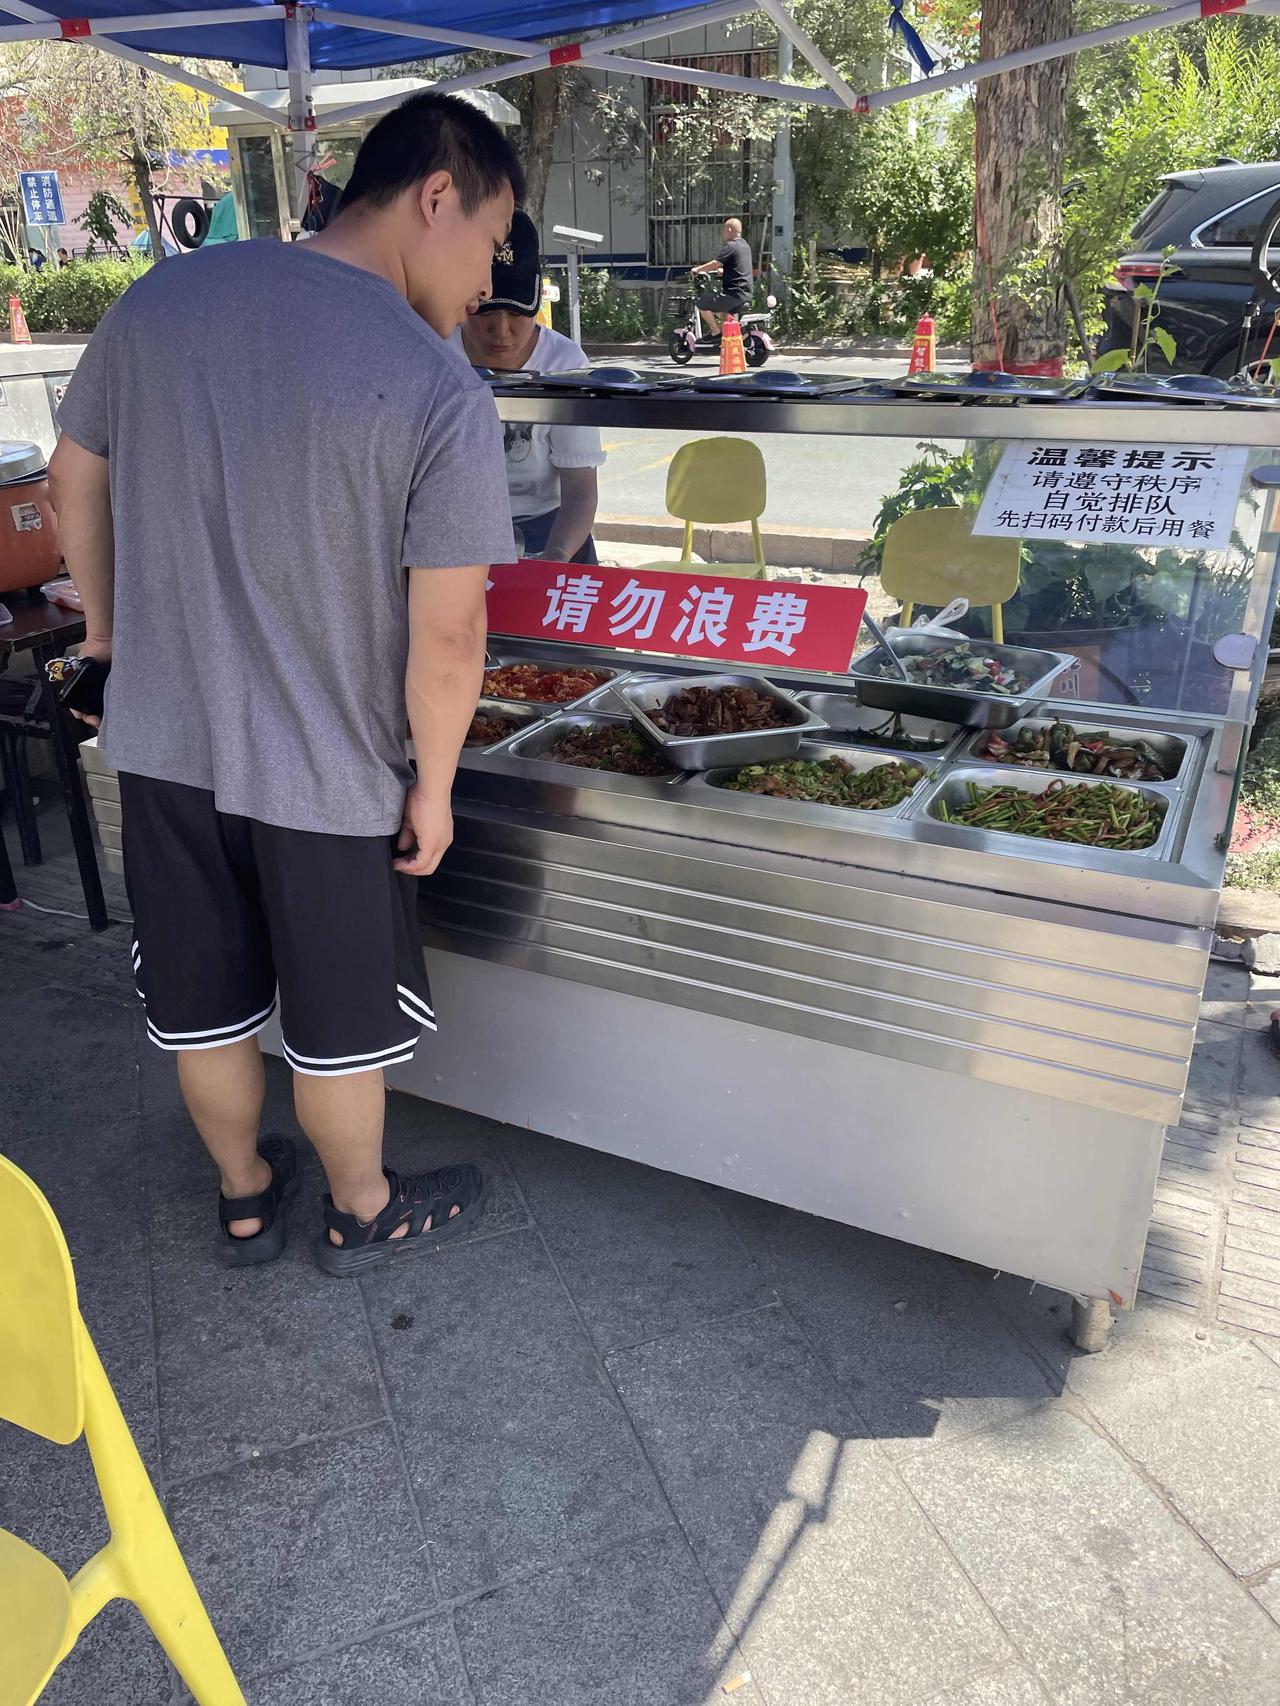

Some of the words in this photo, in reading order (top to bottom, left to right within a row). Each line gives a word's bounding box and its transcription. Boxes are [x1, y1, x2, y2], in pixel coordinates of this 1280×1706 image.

[26, 176, 44, 222] 禁止停车
[41, 175, 58, 221] 消防通道
[1026, 446, 1216, 472] 温馨提示
[1031, 470, 1202, 495] 请遵守秩序
[1043, 489, 1177, 515] 自觉排队
[997, 509, 1216, 540] 先扫码付款后用餐
[542, 573, 809, 657] 请勿浪费
